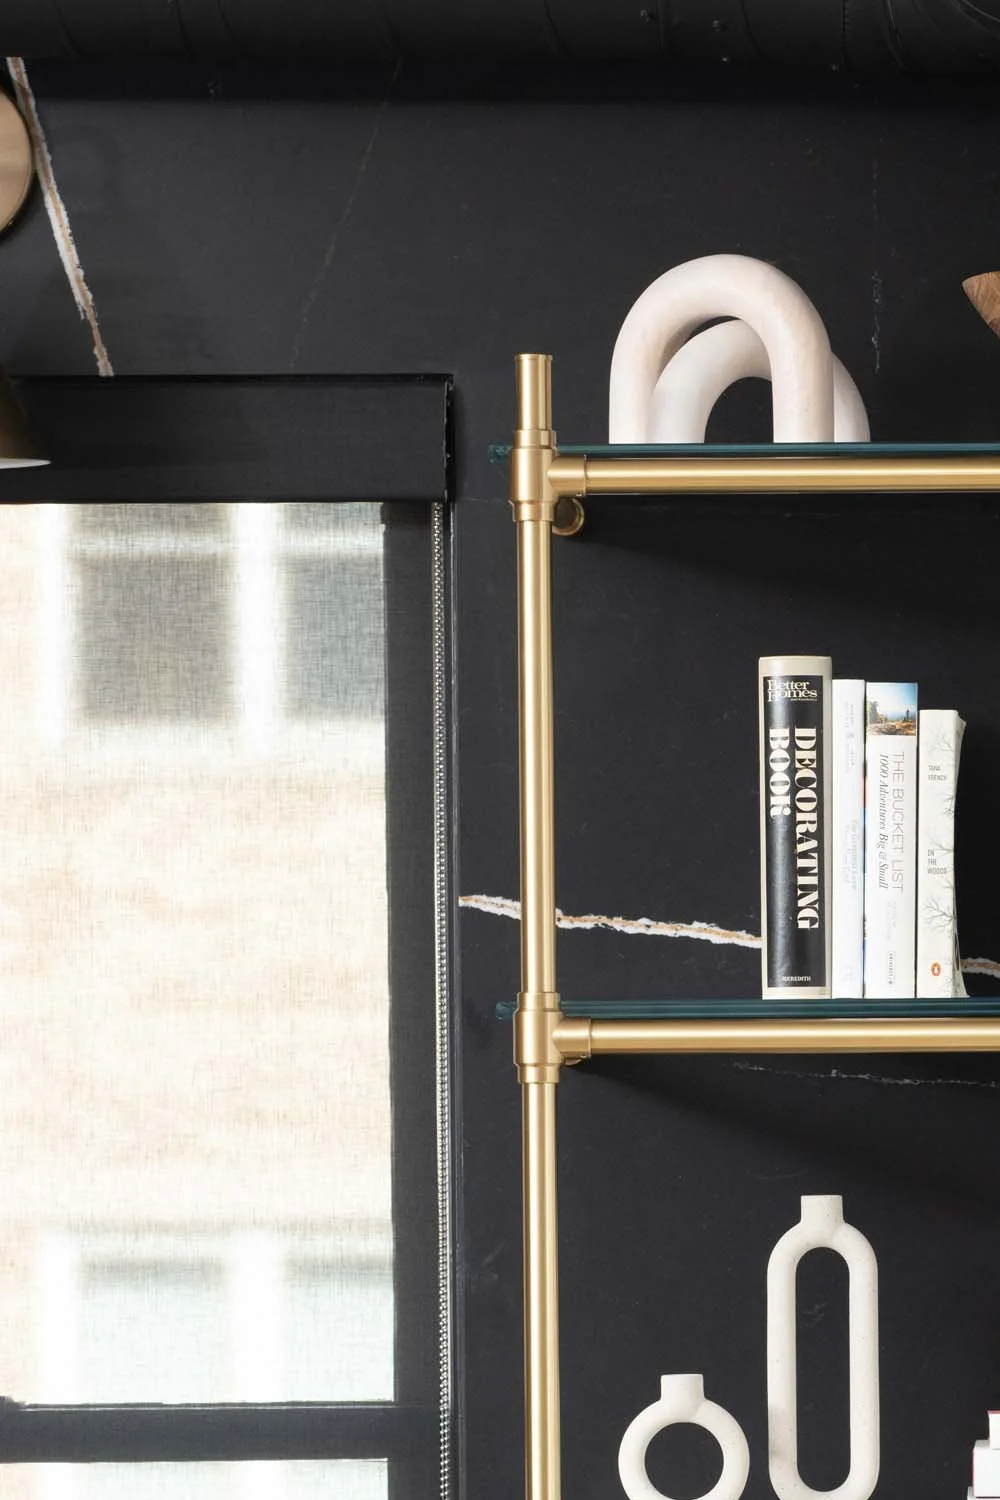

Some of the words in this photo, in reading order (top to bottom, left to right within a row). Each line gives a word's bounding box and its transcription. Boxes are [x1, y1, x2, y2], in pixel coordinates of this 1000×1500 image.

[767, 679, 810, 691] Better
[767, 689, 818, 702] Homes
[769, 727, 791, 819] BOOK
[879, 753, 889, 779] 1000
[891, 751, 905, 784] THE
[878, 779, 889, 830] Adventures
[891, 787, 905, 854] BUCKET
[794, 727, 819, 930] DECORATING
[876, 833, 888, 850] Big
[878, 861, 888, 889] Small
[891, 859, 905, 893] LIST
